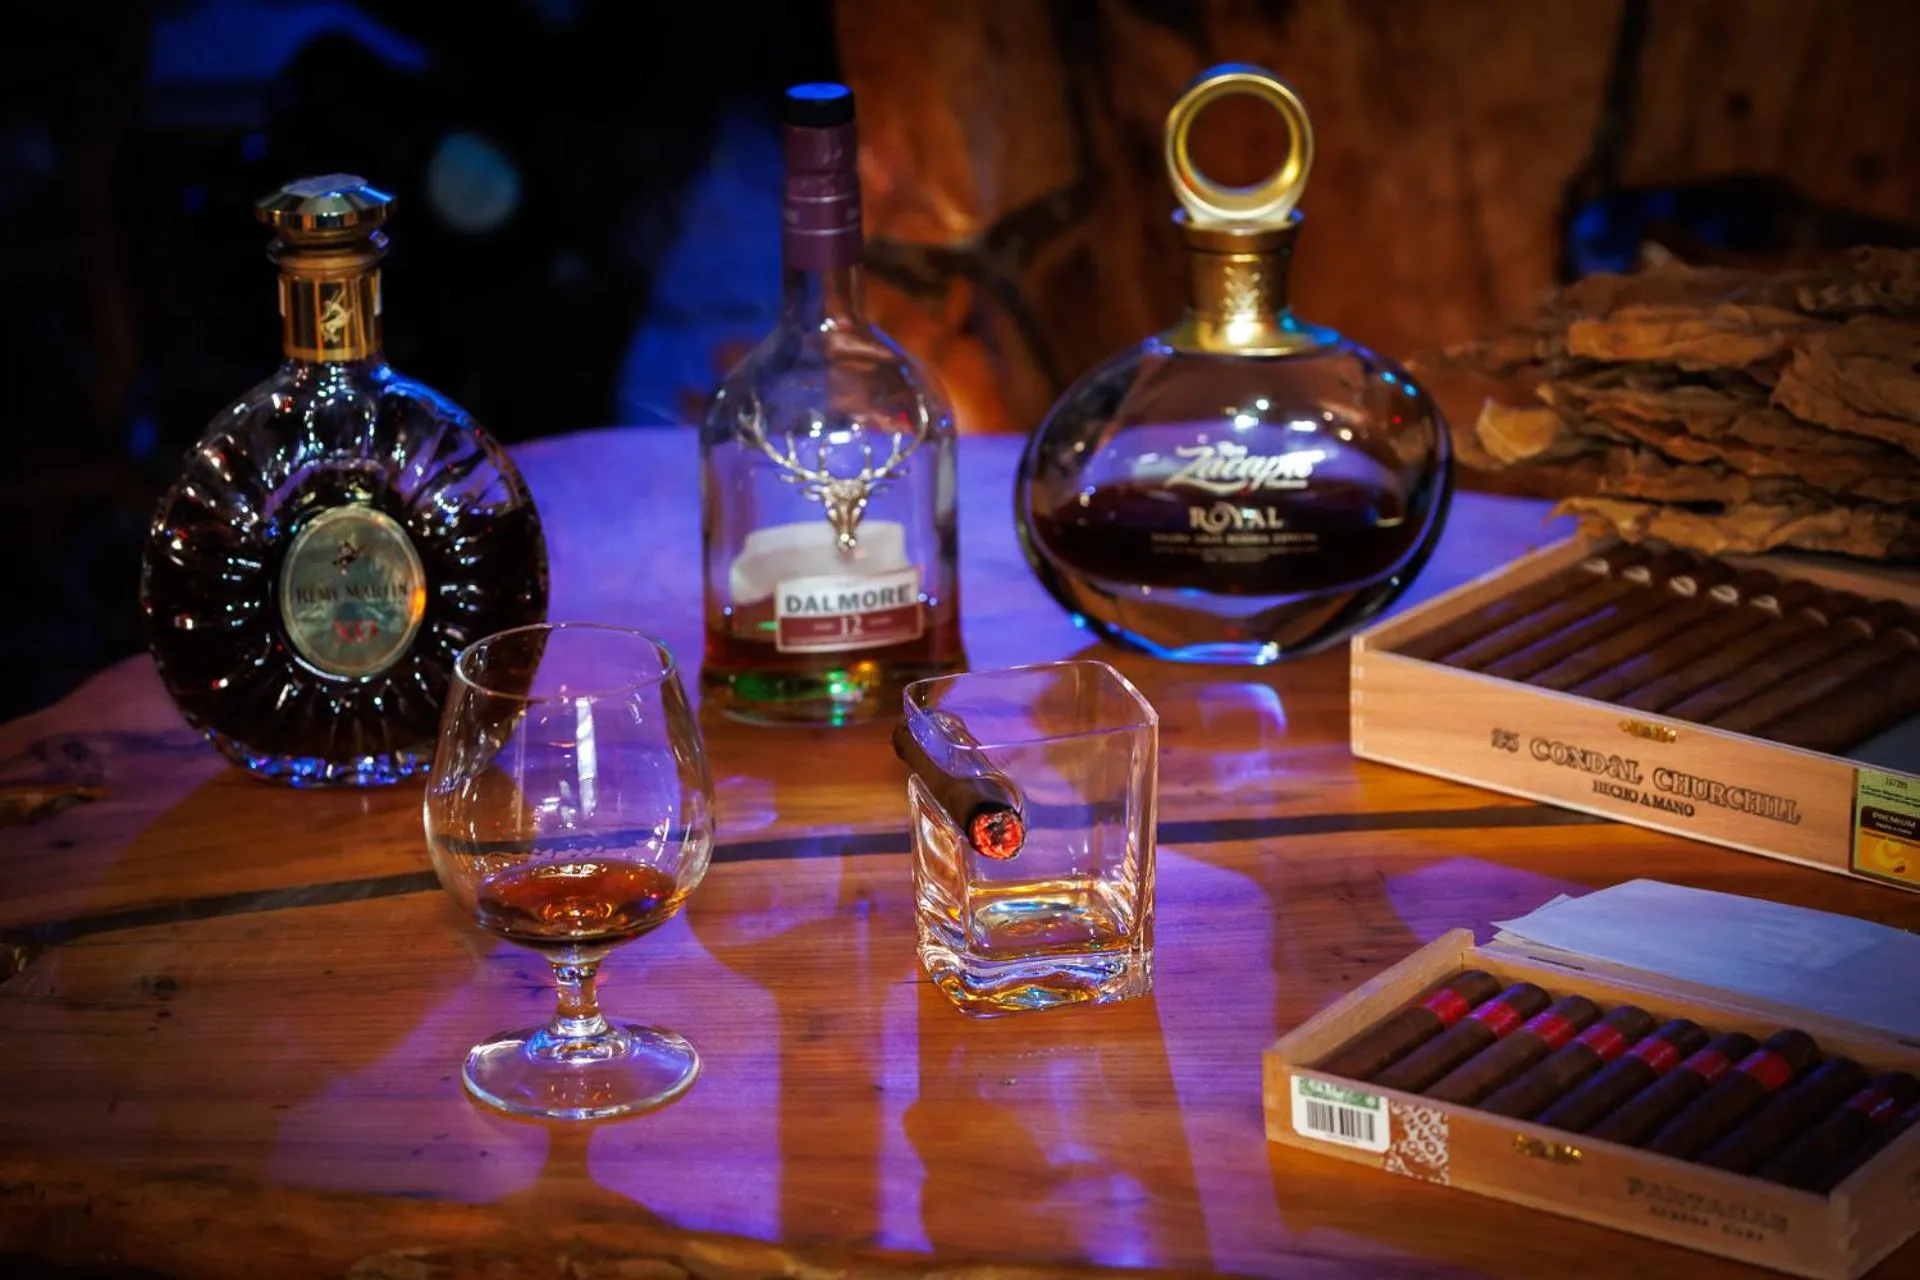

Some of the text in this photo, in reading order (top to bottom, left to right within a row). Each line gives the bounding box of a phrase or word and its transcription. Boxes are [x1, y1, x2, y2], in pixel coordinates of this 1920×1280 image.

[1188, 502, 1284, 534] ROYAL
[786, 584, 911, 612] DALMORE
[1529, 737, 1643, 785] CONDAL
[1653, 767, 1801, 825] CHURCHILL
[1592, 780, 1696, 817] HECHO A MANO
